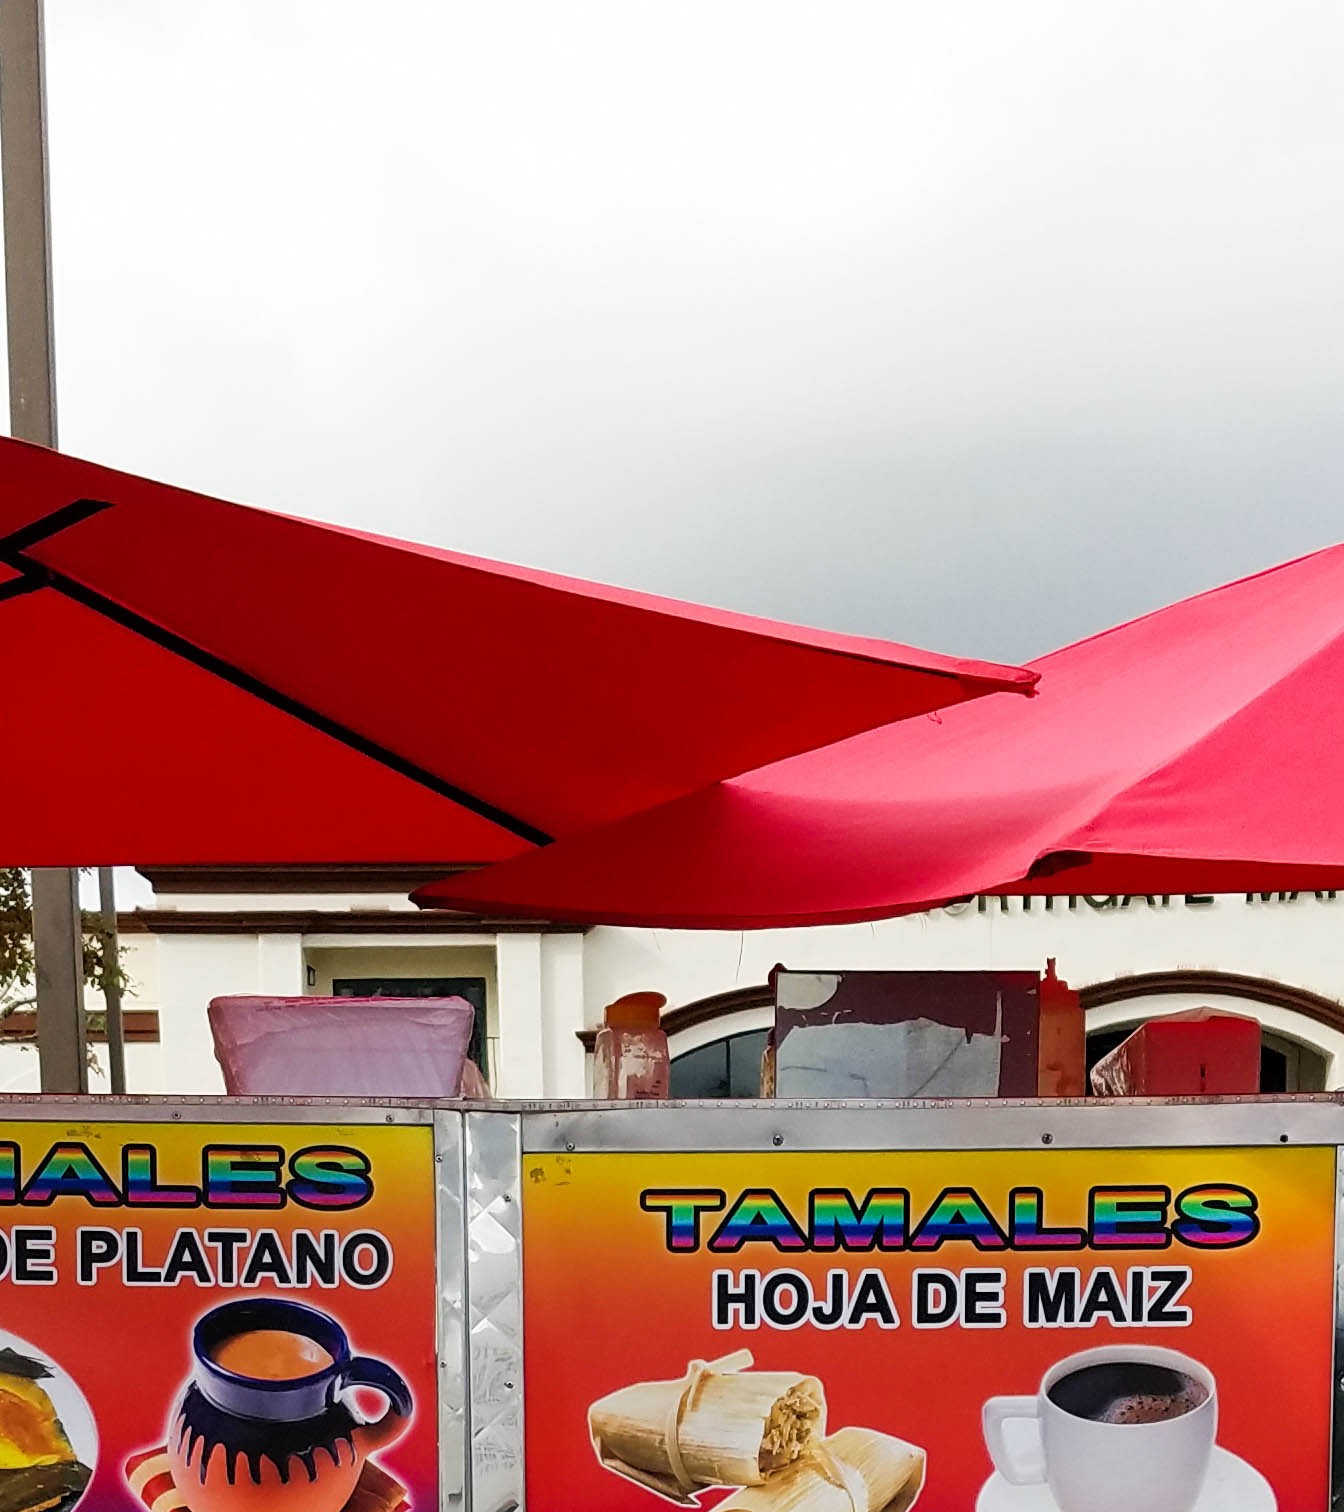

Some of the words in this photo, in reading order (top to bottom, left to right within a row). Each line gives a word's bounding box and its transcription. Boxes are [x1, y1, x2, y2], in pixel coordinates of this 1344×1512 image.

[641, 1183, 1261, 1253] TAMALES
[77, 1228, 392, 1288] PLATANO
[713, 1267, 899, 1330] HOJA
[913, 1268, 1007, 1328] DE
[1024, 1265, 1193, 1327] MAIZ
